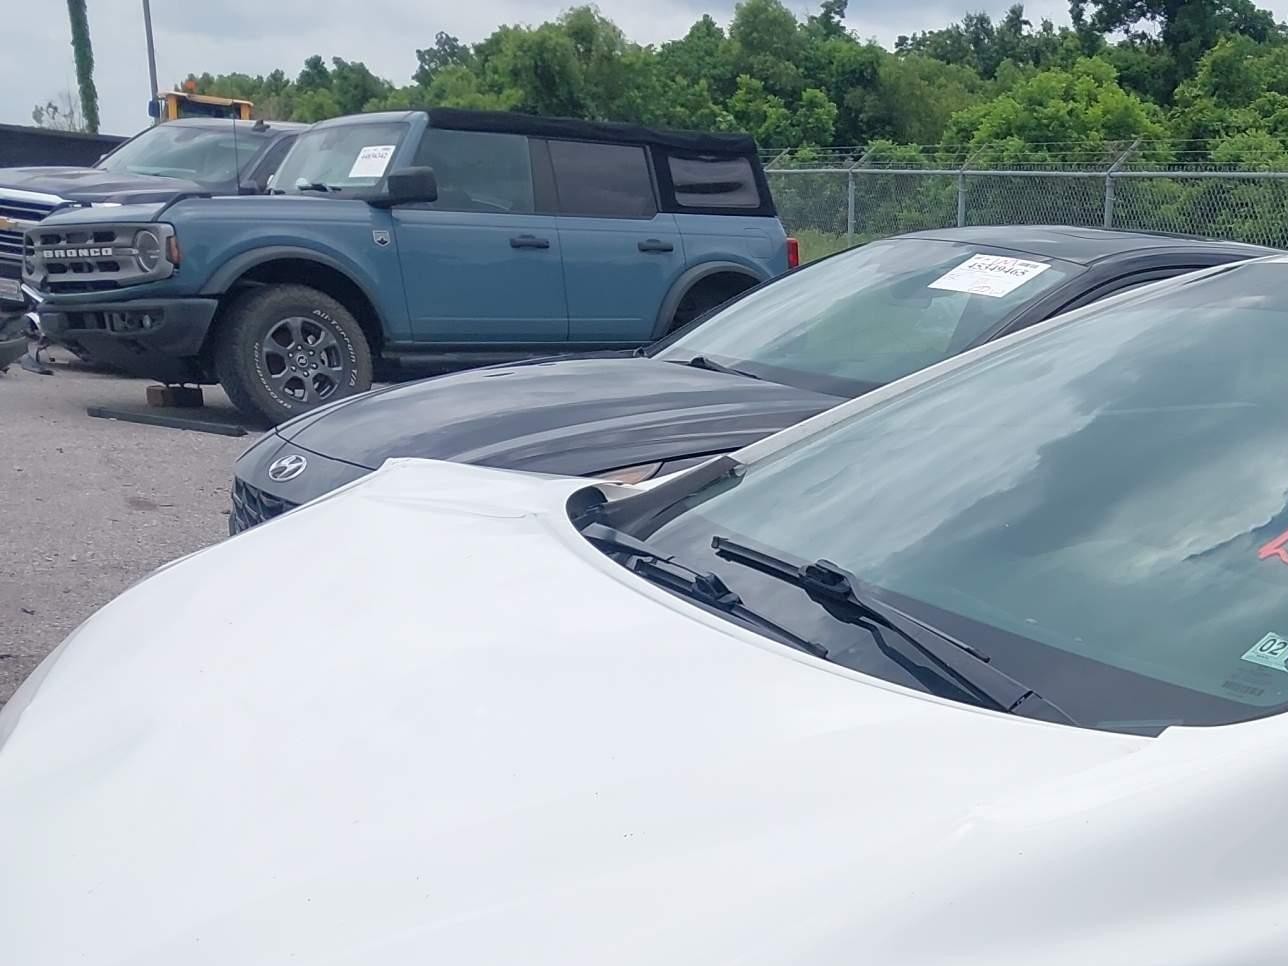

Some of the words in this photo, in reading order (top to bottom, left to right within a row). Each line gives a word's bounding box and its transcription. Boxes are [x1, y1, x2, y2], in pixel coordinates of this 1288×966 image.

[42, 247, 113, 258] BRONCO
[348, 368, 359, 387] T/A
[1259, 638, 1288, 656] 02
